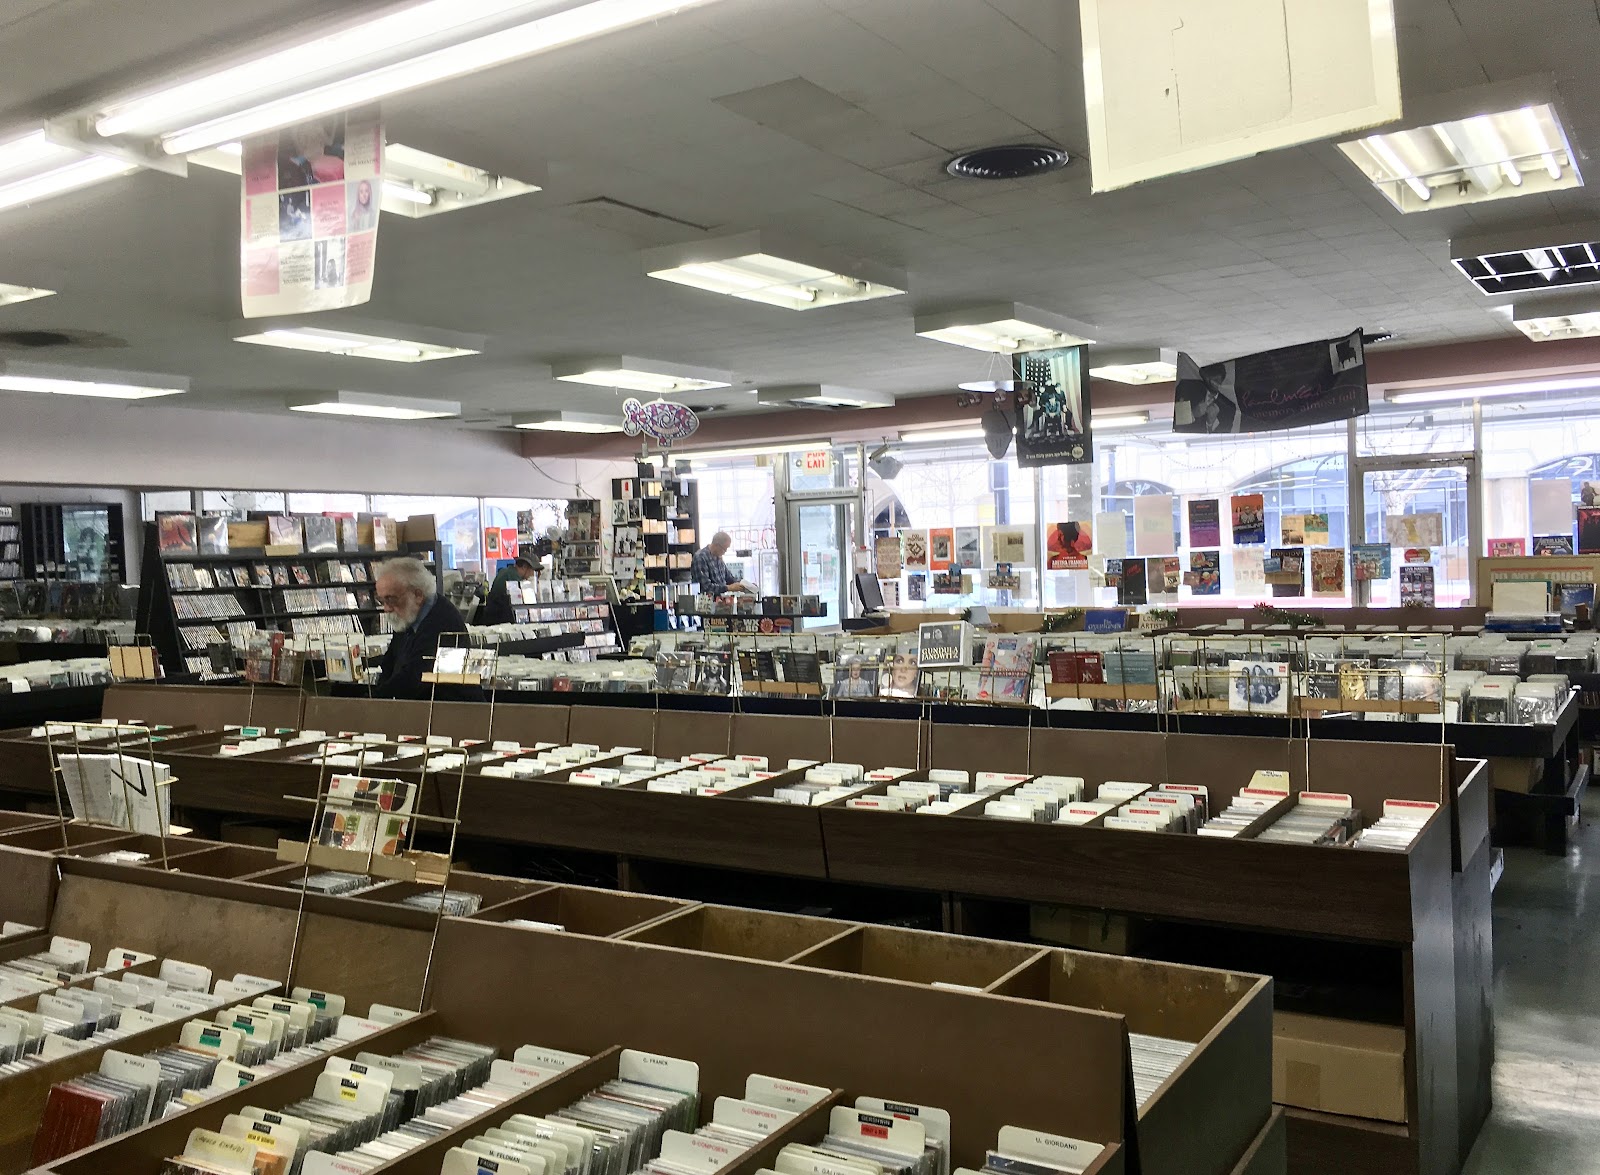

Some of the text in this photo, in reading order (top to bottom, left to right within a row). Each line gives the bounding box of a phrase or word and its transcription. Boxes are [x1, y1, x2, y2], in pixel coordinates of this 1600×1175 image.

[1543, 571, 1593, 582] TOUCH
[922, 646, 959, 656] GUNDULA
[650, 1058, 669, 1066] FRANCK
[774, 1083, 809, 1095] G-COMPOSERS
[741, 1107, 777, 1119] G-COMPOSERS
[886, 1105, 916, 1114] GERSHWIN
[861, 1116, 890, 1126] GERSHWIN
[691, 1140, 728, 1154] G-COMPOSERS
[1044, 1140, 1077, 1151] GIORDANO
[496, 1153, 520, 1163] FELDMAN
